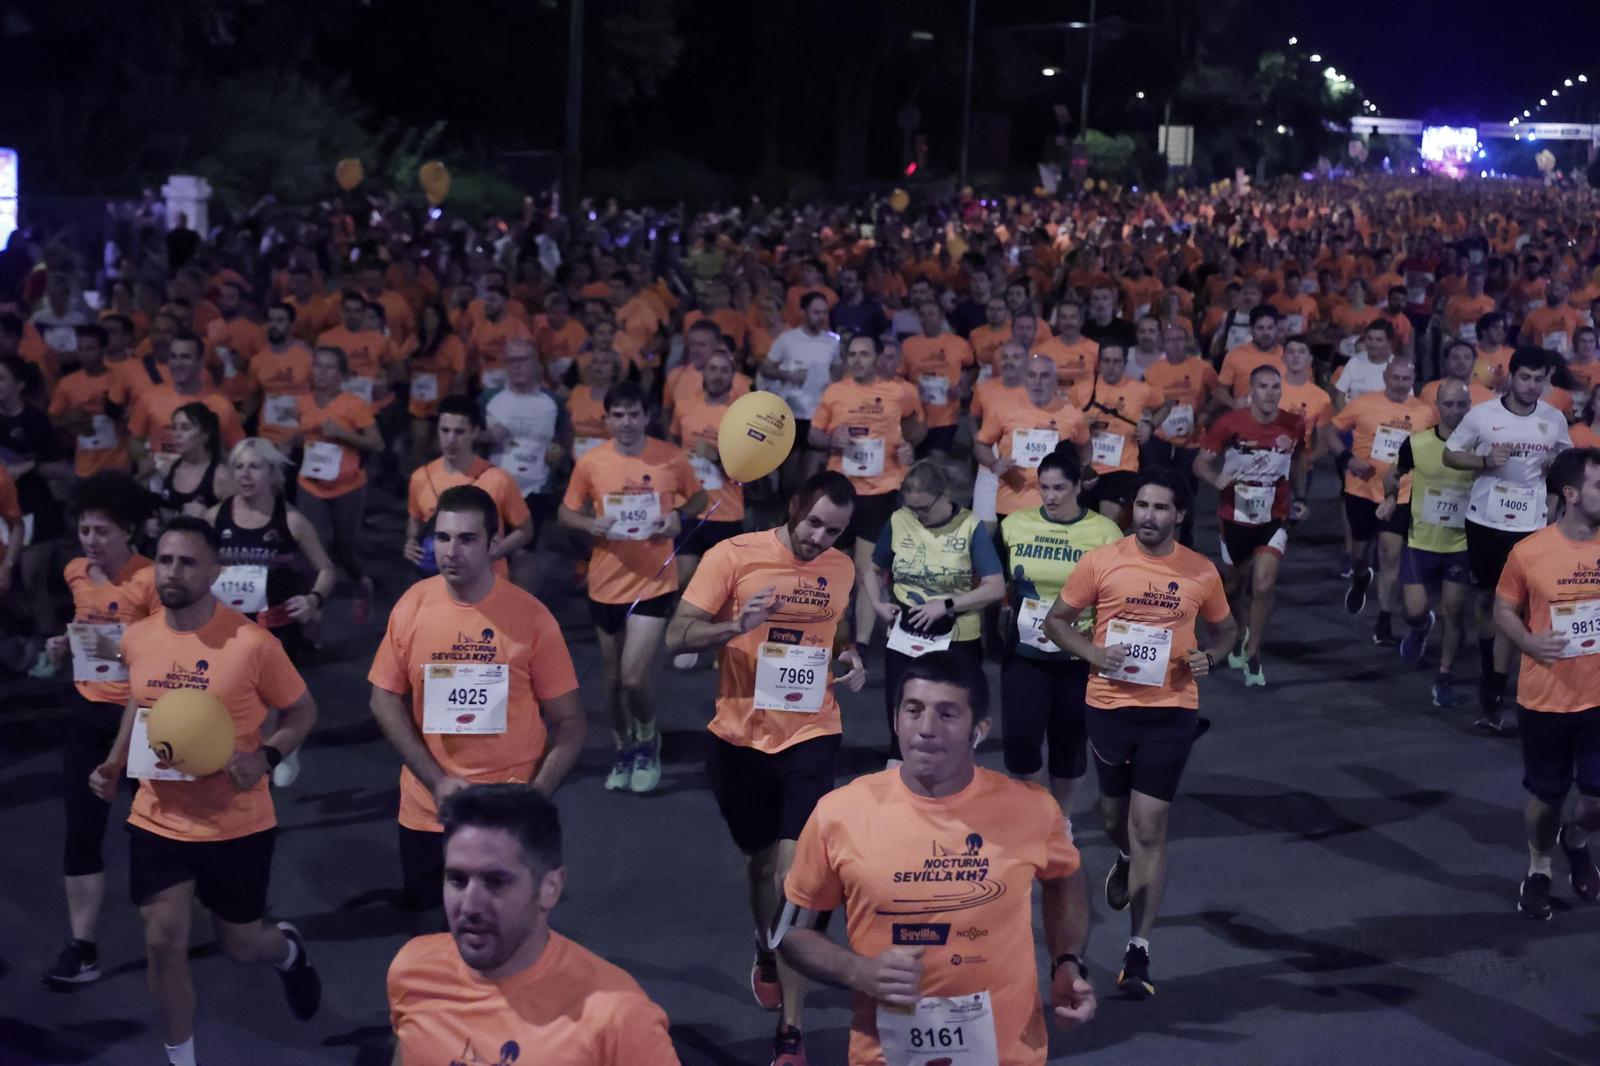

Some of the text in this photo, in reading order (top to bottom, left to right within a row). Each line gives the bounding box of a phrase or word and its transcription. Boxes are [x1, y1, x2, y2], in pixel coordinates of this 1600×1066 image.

[1024, 442, 1047, 453] 4589
[1436, 501, 1459, 512] 7776
[1499, 498, 1528, 512] 14005
[620, 509, 647, 522] 8450
[1034, 535, 1069, 545] RUNNERS
[1015, 543, 1089, 563] BARREÑO
[220, 581, 256, 594] 17145
[1557, 578, 1589, 586] SEVILLA
[775, 594, 810, 605] SEVILLA
[793, 588, 831, 599] NOCTURNA
[1143, 591, 1181, 602] NOCTURNA
[1125, 596, 1159, 607] SEVILLA
[1571, 618, 1600, 635] 9813
[452, 644, 497, 653] NOCTURNA
[1119, 641, 1157, 661] 3883
[431, 652, 471, 661] SEVILLA
[166, 672, 210, 685] NOCTURNA
[779, 667, 814, 685] 7969
[146, 679, 183, 689] SEVILLA
[448, 688, 488, 706] 4925
[923, 857, 990, 869] NOCTURNA
[893, 870, 953, 883] SEVILLA
[910, 1026, 964, 1048] 8161
